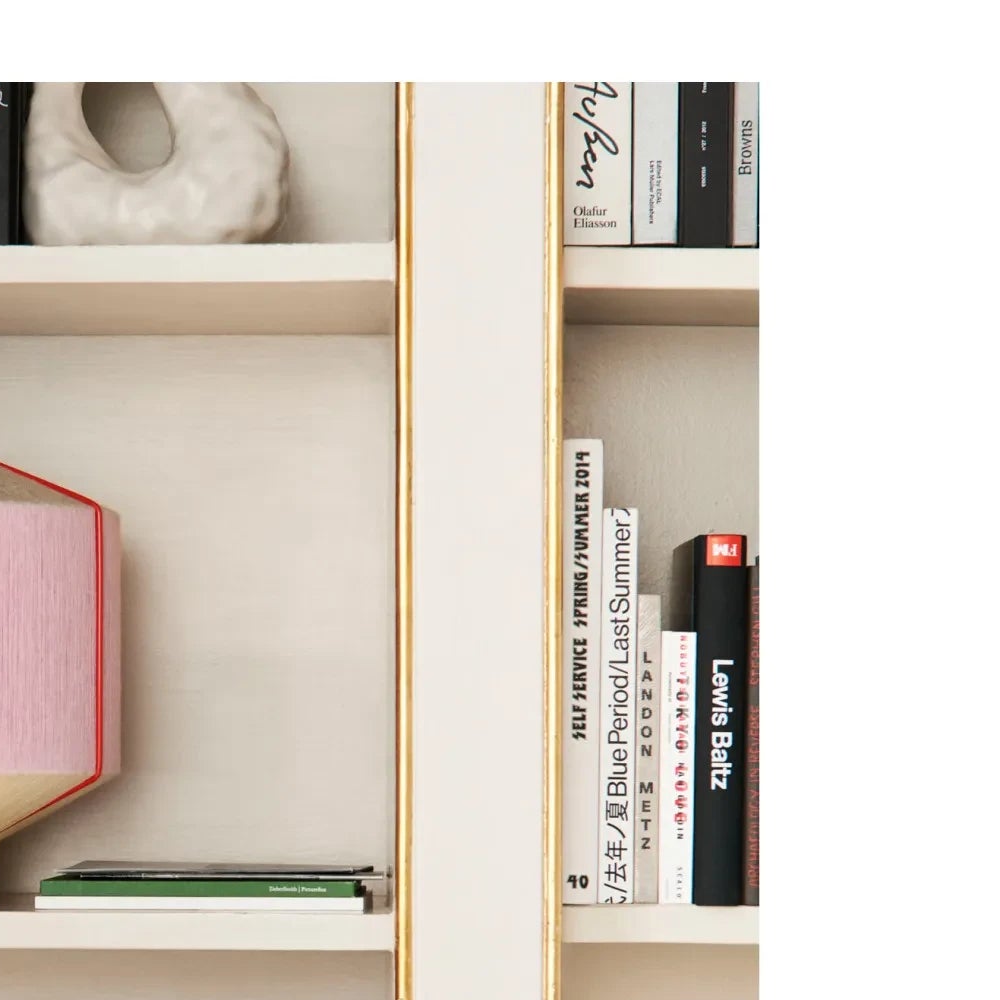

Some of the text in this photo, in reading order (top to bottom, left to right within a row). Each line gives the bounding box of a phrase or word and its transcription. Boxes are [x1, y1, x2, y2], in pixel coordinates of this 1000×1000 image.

[738, 120, 753, 175] Browns
[573, 206, 607, 217] Olafur
[573, 218, 617, 229] Eliasson
[609, 521, 631, 614] Summer
[572, 638, 587, 699] SERVICE
[572, 704, 587, 740] SELF
[710, 659, 734, 790] Lewis Baltz
[607, 748, 628, 796] Blue
[639, 651, 653, 849] LANDON METZ
